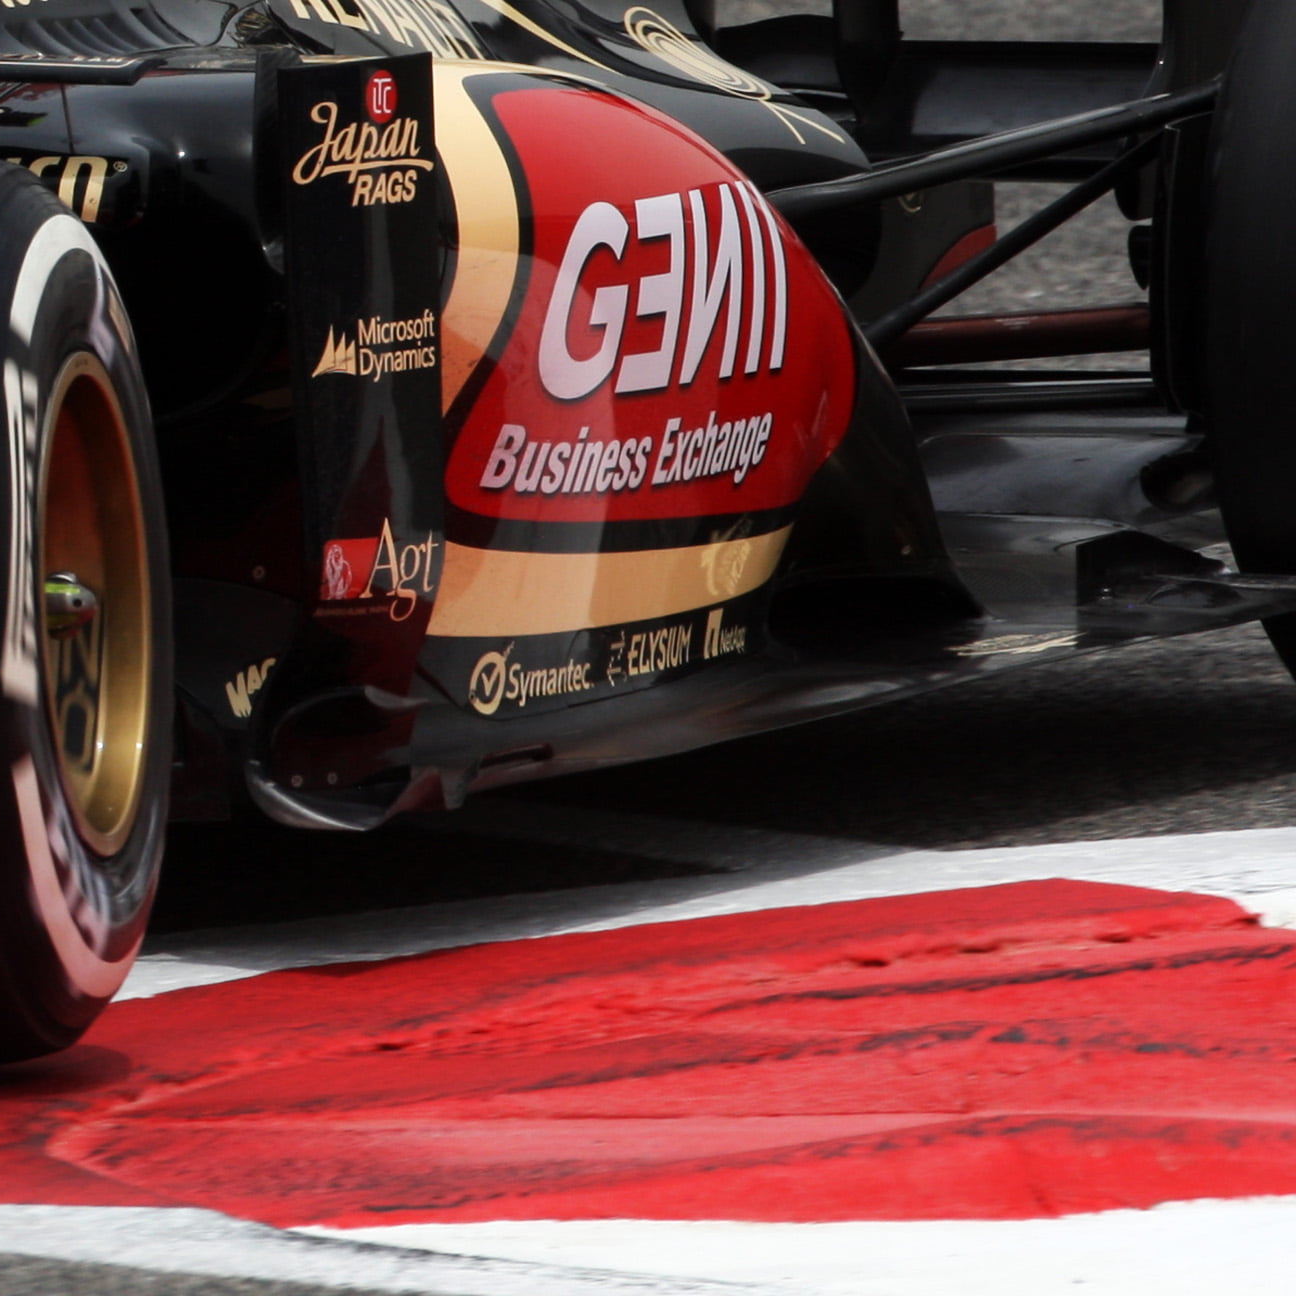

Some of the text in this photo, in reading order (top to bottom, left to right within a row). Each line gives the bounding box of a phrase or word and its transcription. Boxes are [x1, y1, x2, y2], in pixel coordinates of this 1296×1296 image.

[292, 102, 422, 185] Japan
[352, 169, 417, 207] RAGS
[358, 309, 435, 346] Microsoft
[359, 342, 435, 383] Dynamics
[480, 410, 772, 494] Business Exchange
[627, 623, 693, 677] ELYSIUM
